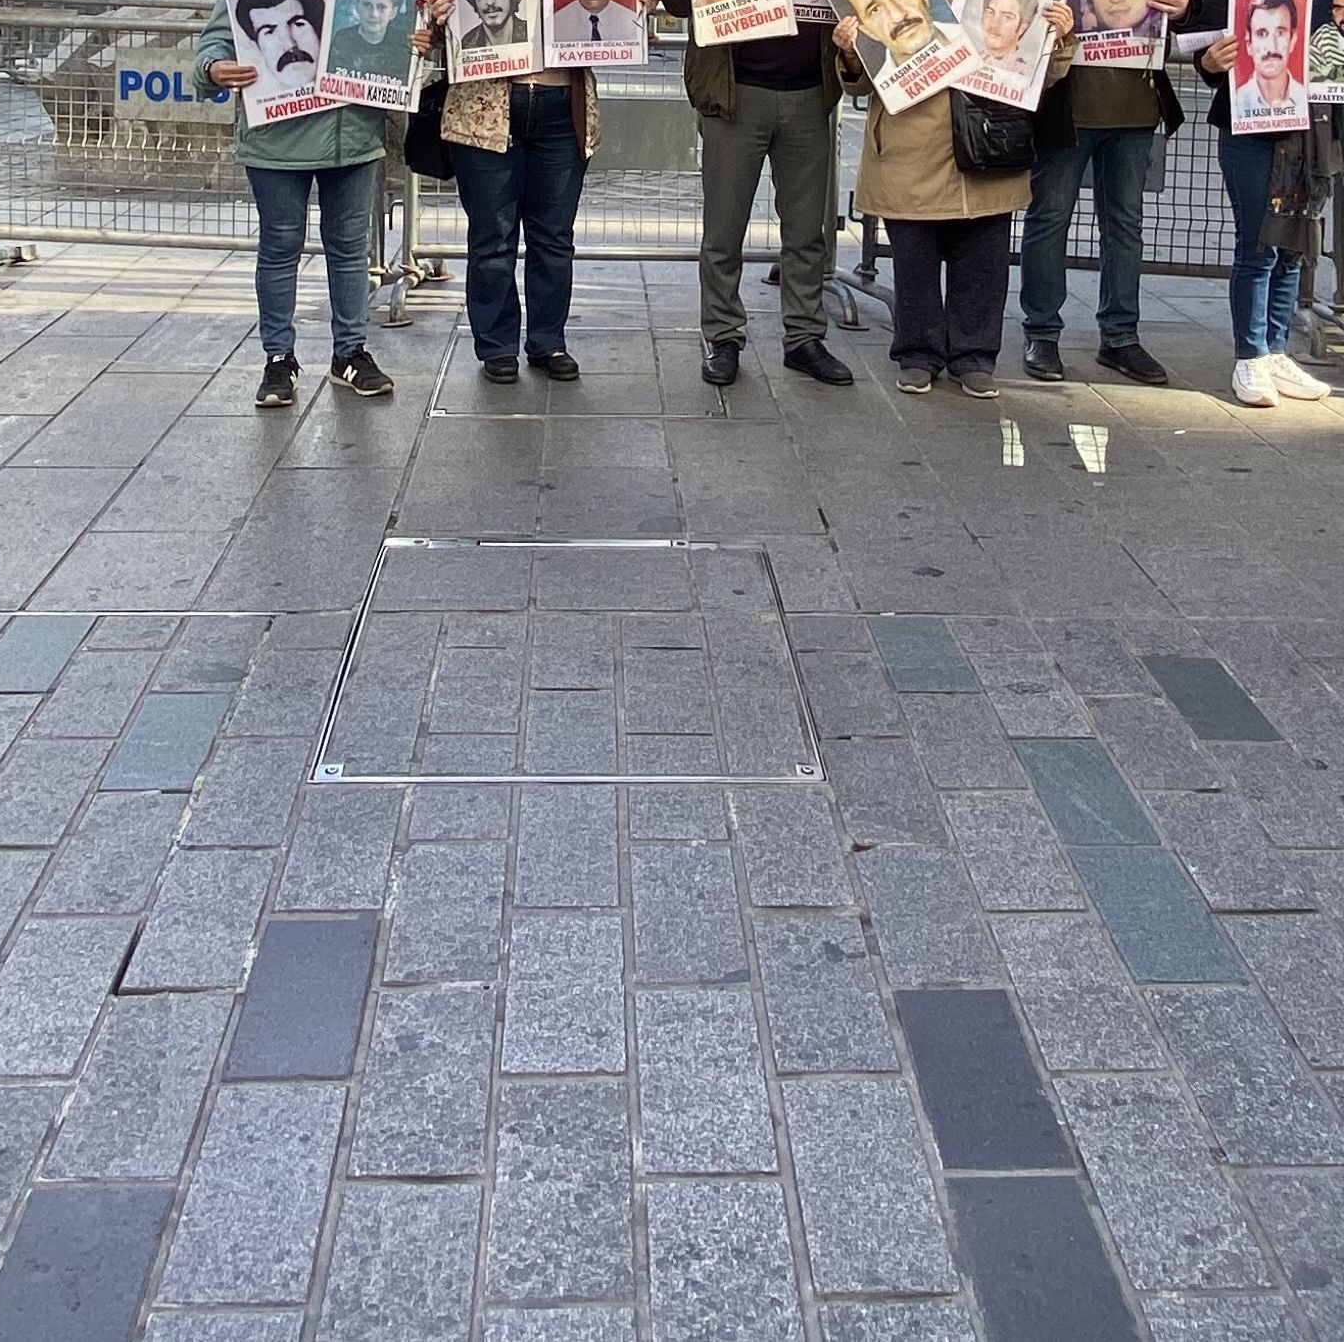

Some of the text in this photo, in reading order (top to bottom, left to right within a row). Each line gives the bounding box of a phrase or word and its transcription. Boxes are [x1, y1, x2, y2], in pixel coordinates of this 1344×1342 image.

[714, 5, 788, 38] KAYBEDİLDİ
[463, 58, 529, 77] KAYBEDİLDİ
[559, 49, 633, 61] KAYBEDİLDİ
[119, 69, 233, 103] POL
[319, 76, 366, 98] GÖZALTINDA
[904, 45, 971, 99] KAYBEDİLDİ
[956, 72, 1024, 102] AYBEDİLDİ
